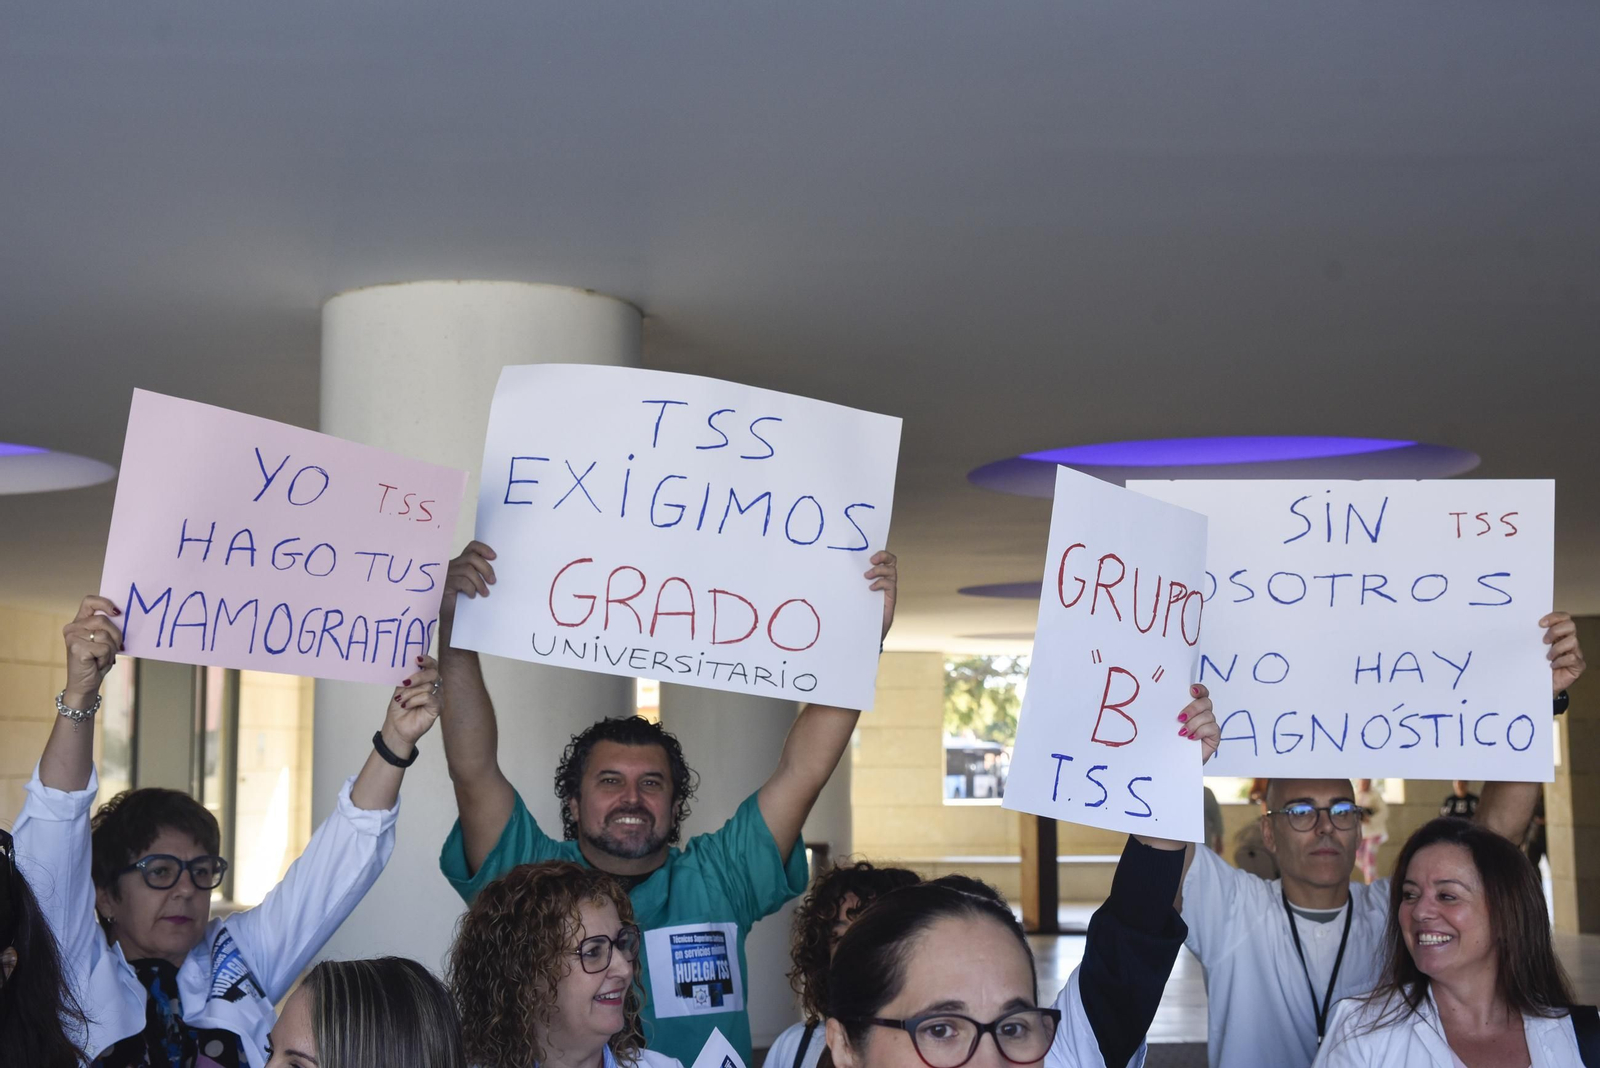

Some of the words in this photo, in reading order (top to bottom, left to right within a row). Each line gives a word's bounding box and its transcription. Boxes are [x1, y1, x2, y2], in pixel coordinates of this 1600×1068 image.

[642, 400, 783, 460] TSS
[253, 447, 330, 506] YO
[1449, 512, 1519, 538] TSS
[178, 518, 336, 577] HAGO
[354, 551, 440, 593] TUS
[549, 557, 821, 652] GRADO
[1058, 543, 1204, 647] GRUPO
[1204, 569, 1513, 607] SOTROS
[1199, 652, 1290, 683] NO
[1355, 650, 1472, 690] HAY
[1051, 753, 1158, 823] T.S.S.
[675, 950, 683, 960] en
[684, 946, 711, 959] servicios
[675, 960, 716, 984] HUELGA
[716, 959, 730, 980] TSS
